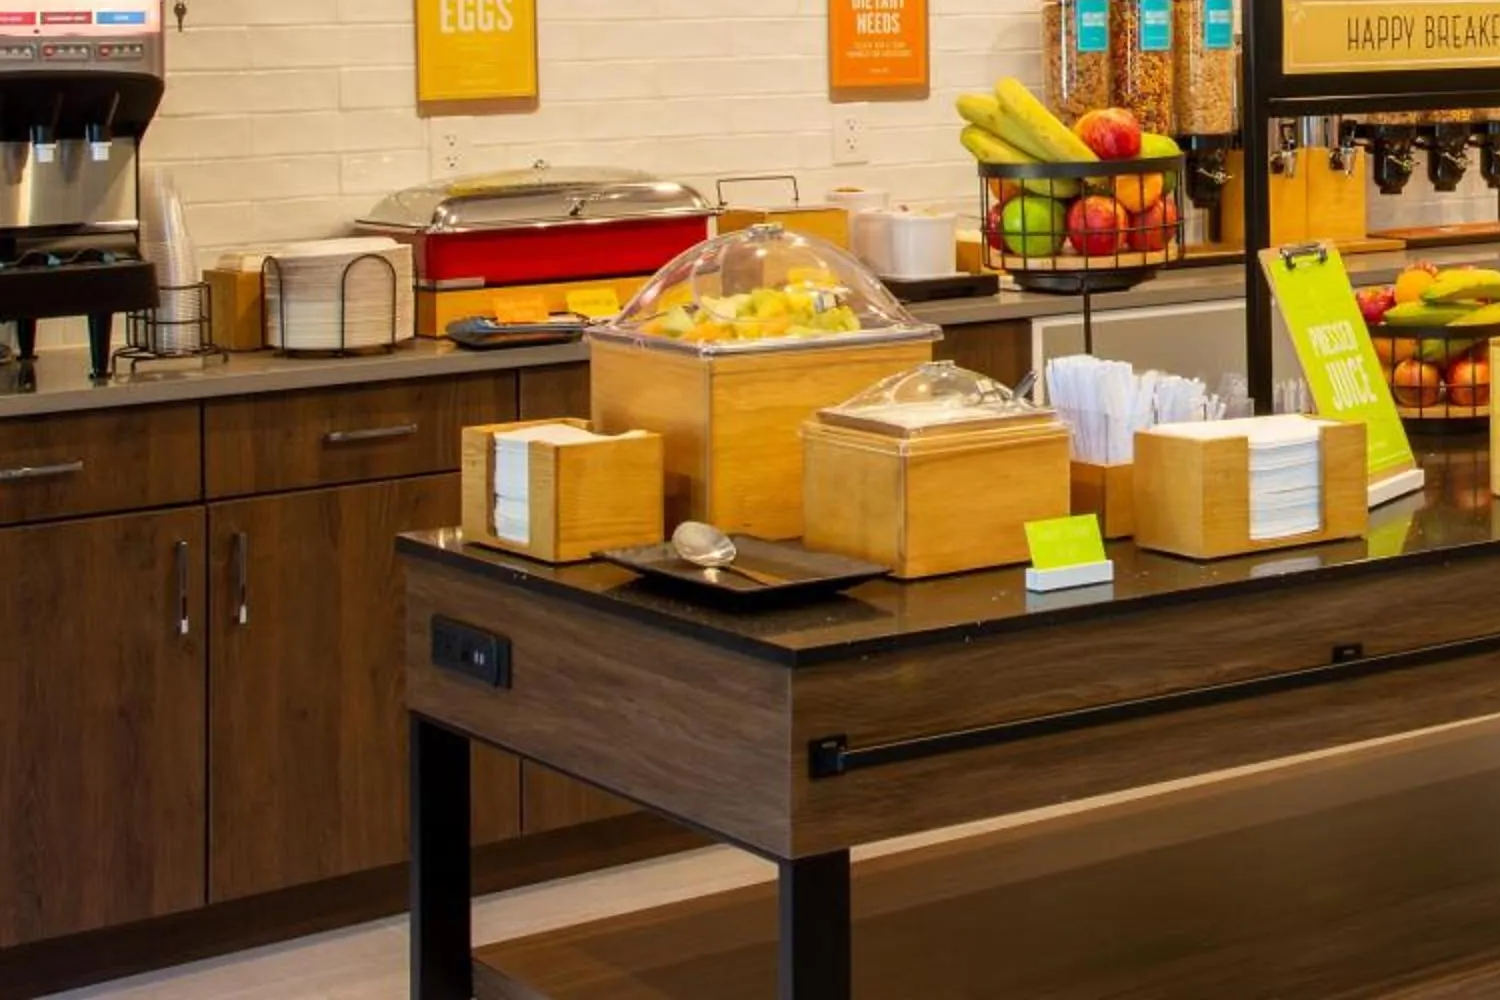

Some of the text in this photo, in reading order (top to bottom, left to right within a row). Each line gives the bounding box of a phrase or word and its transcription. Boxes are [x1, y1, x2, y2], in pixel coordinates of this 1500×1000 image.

[856, 12, 901, 34] NEEDS
[1346, 15, 1414, 51] HAPPY
[1325, 354, 1377, 411] JUICE
